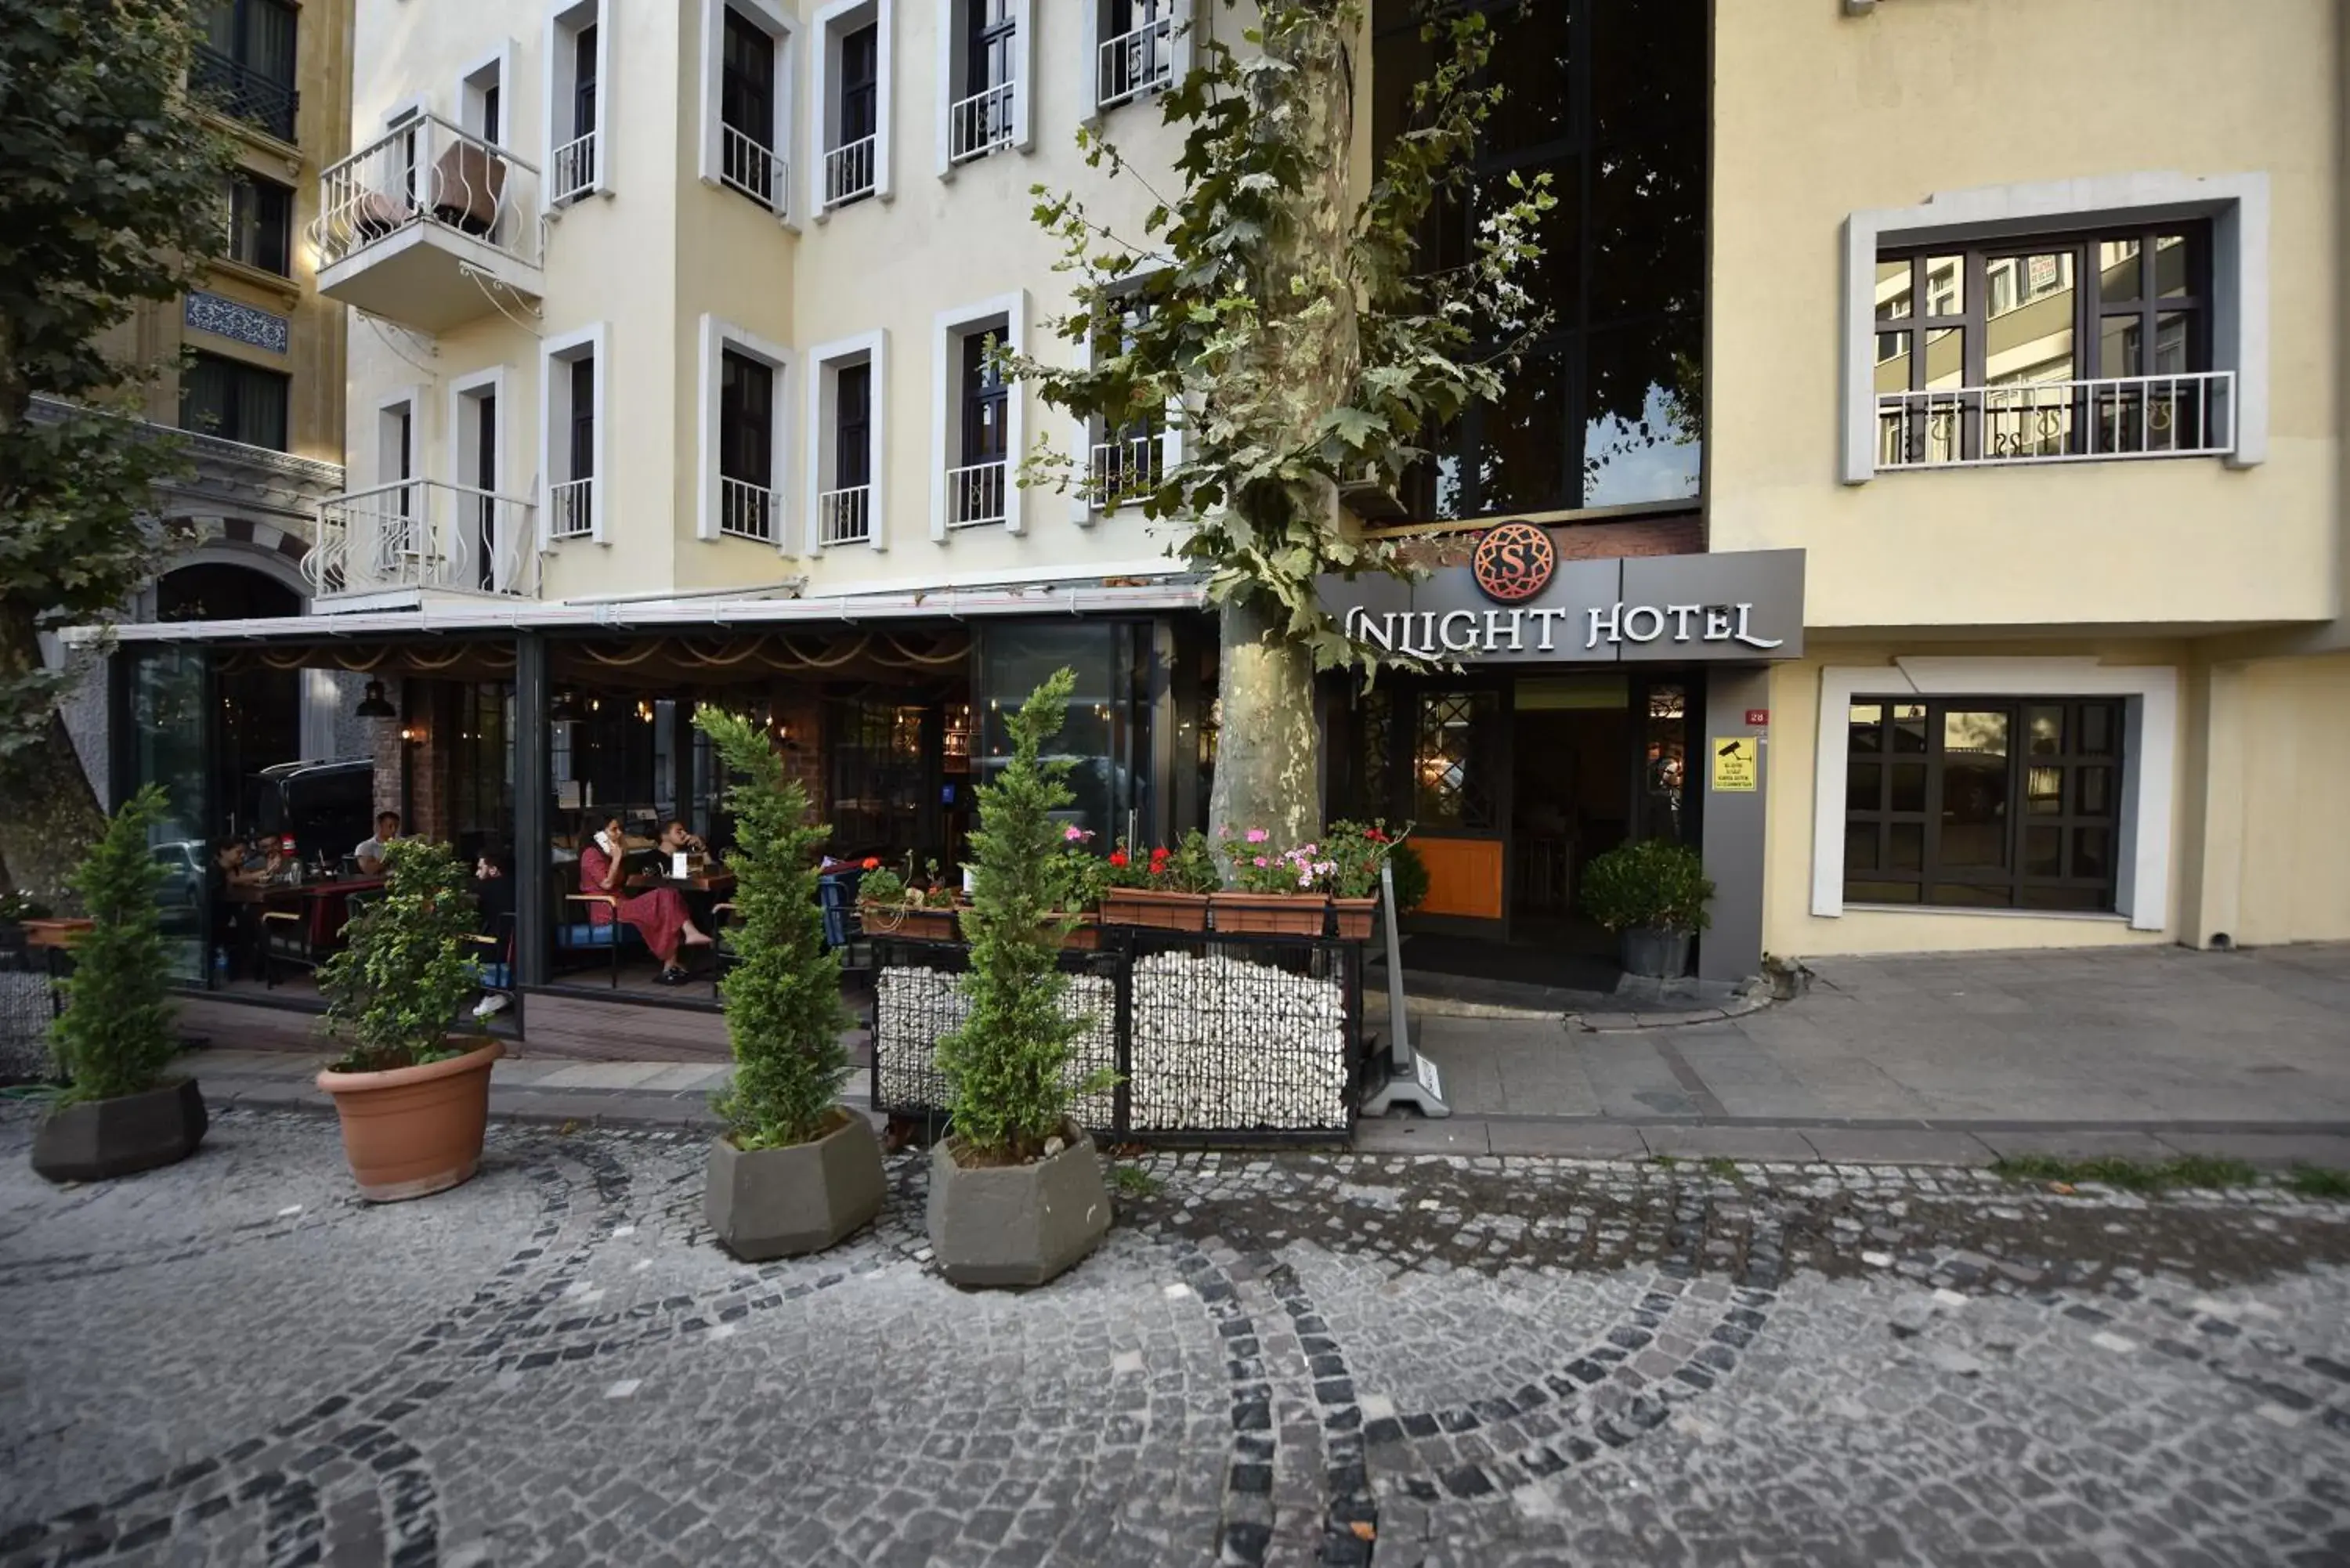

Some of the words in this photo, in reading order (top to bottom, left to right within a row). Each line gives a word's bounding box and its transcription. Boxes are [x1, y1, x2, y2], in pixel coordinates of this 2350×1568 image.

[1501, 544, 1524, 579] S
[1586, 602, 1784, 649] HOTEL
[1751, 713, 1763, 722] 28
